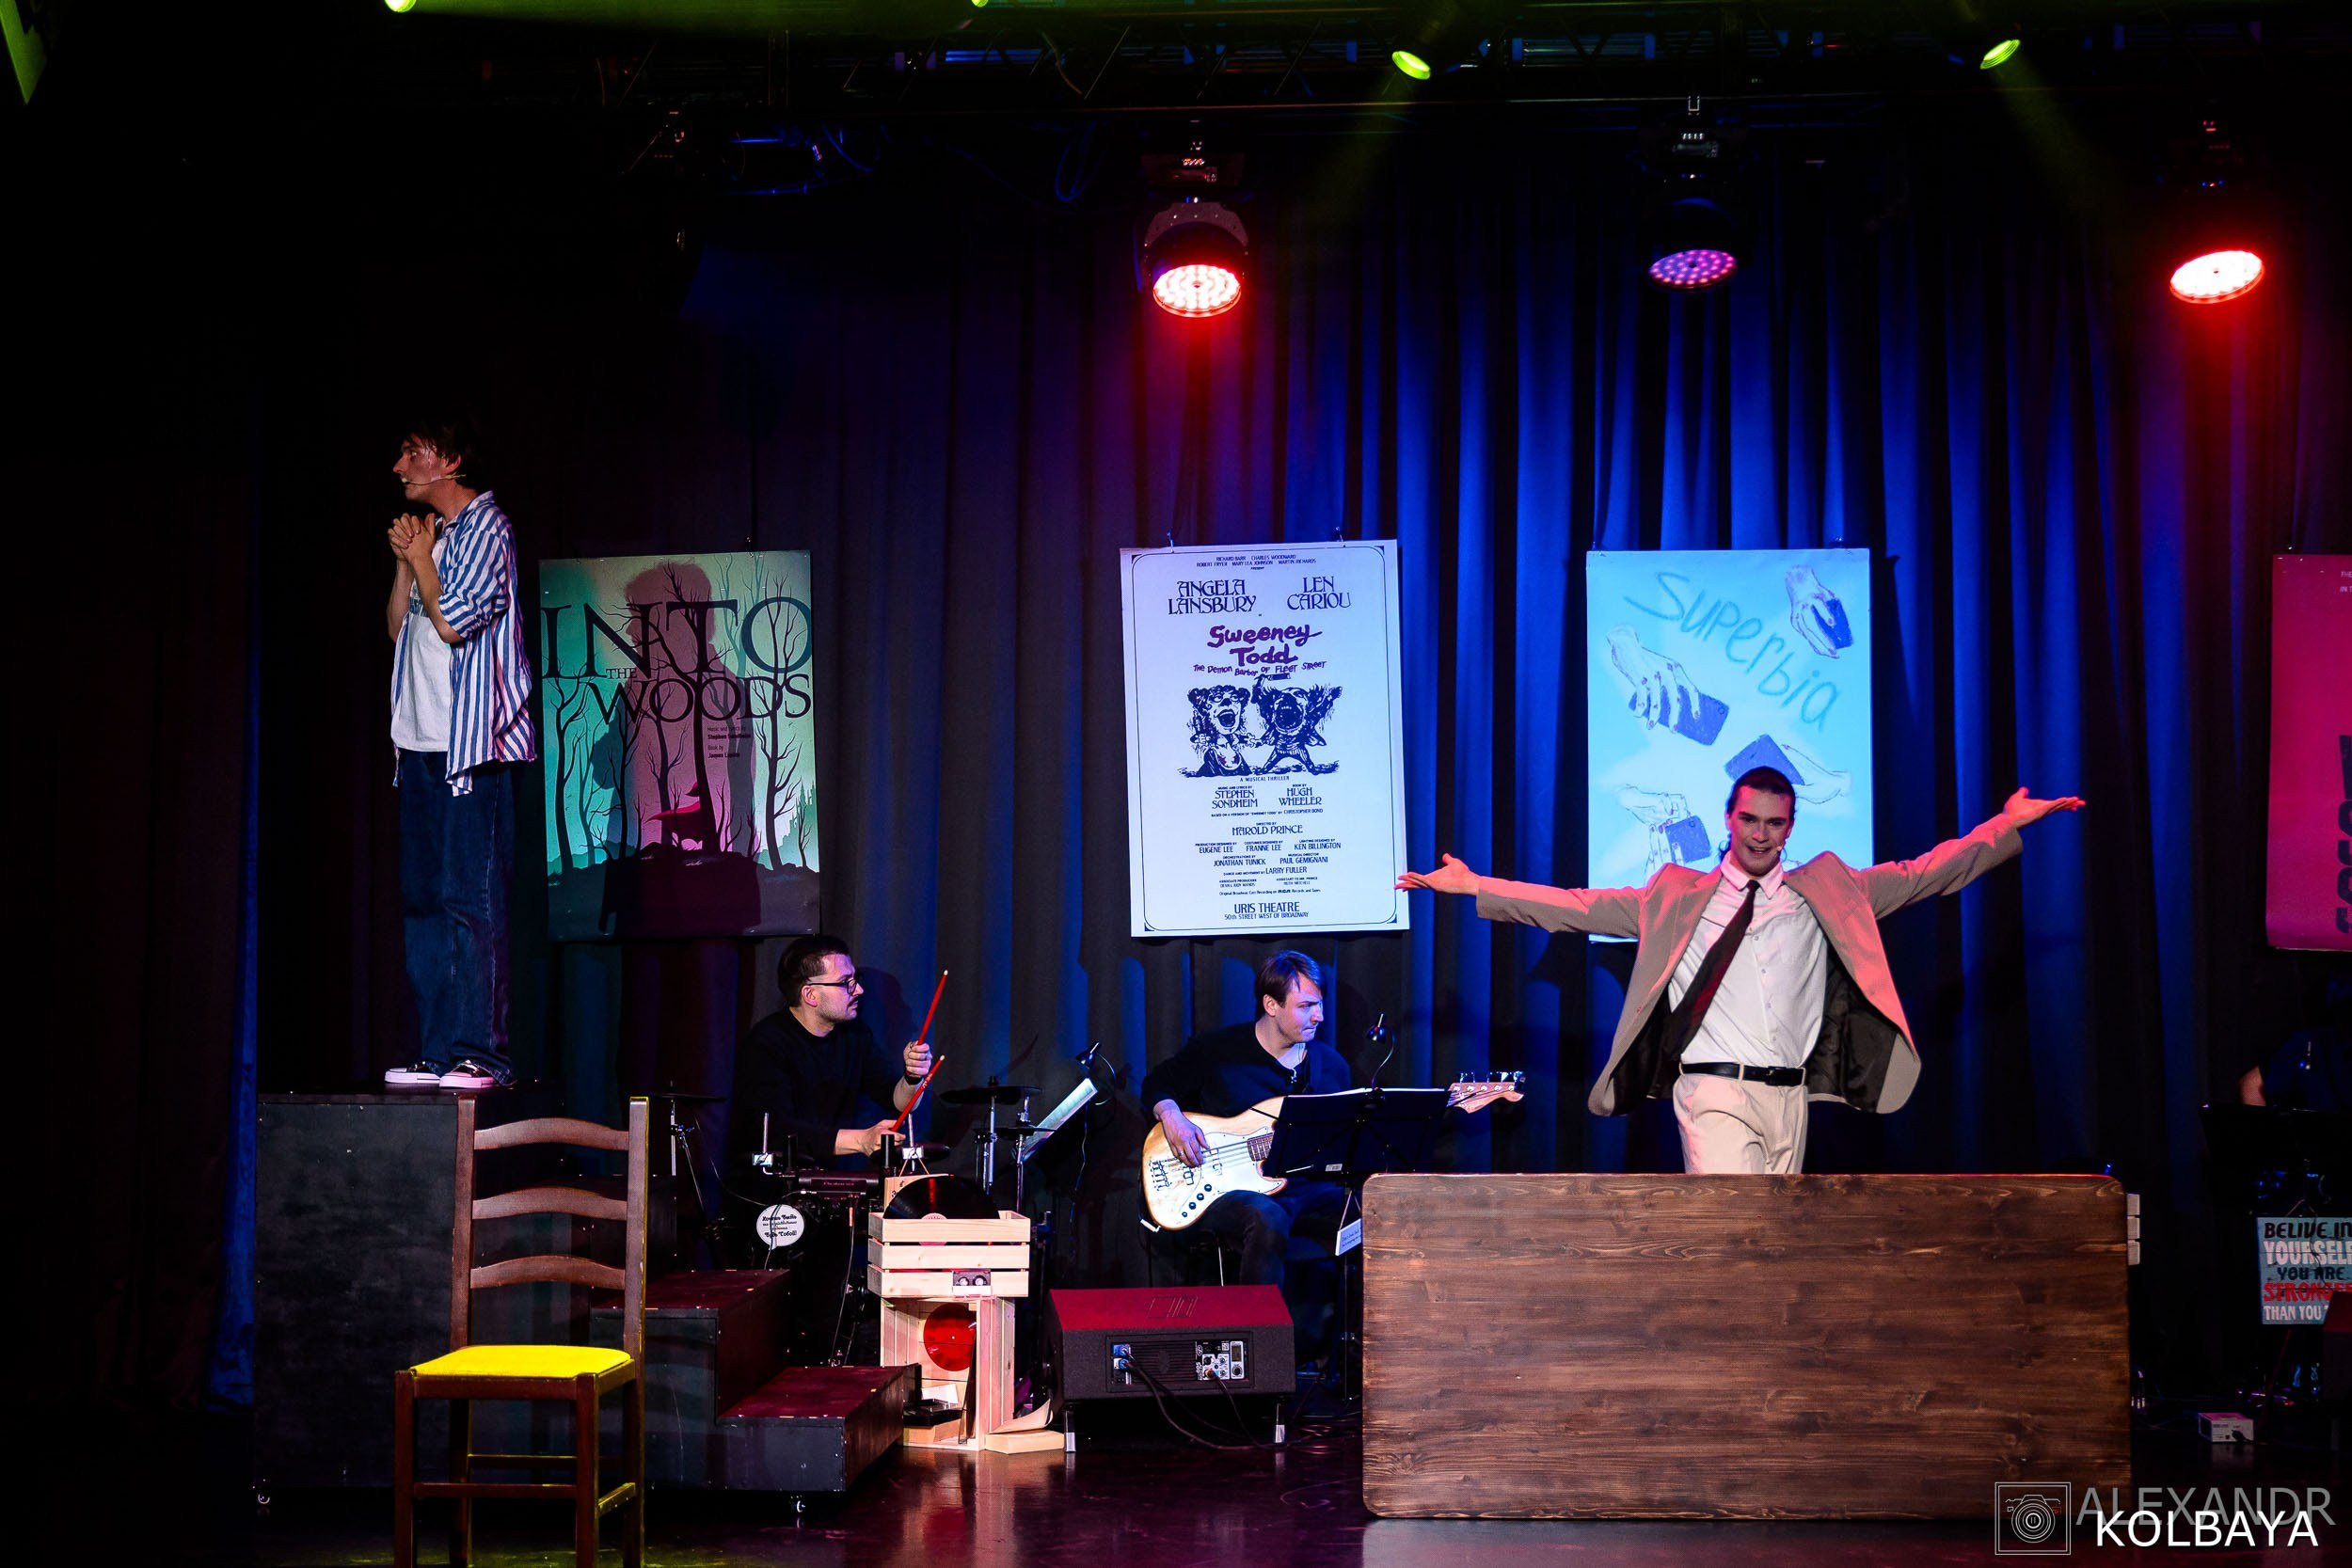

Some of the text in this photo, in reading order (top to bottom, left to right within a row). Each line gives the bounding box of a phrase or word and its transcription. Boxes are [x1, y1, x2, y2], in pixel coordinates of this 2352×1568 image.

[1177, 579, 1246, 597] ANGELA
[1302, 576, 1335, 593] LEN
[1168, 594, 1257, 615] LANSBURY
[1286, 592, 1351, 611] CARIOU
[540, 596, 812, 679] INTO
[1207, 623, 1323, 648] Sweeney
[1229, 643, 1299, 667] Todd
[606, 667, 636, 680] THE
[588, 673, 812, 723] WOODS
[1215, 789, 1255, 799] STEPHEN
[1286, 787, 1313, 797] HUGH
[1212, 798, 1258, 809] SONDHEIM
[1279, 796, 1322, 806] WHEELER
[1232, 824, 1303, 836] HAROLD PRINCE
[1234, 901, 1300, 914] URIS THEATRE
[2264, 1222, 2328, 1239] BELIVE
[2277, 1266, 2346, 1281] YOU ARE
[2263, 1305, 2296, 1320] THAN
[2298, 1305, 2322, 1320] YOU
